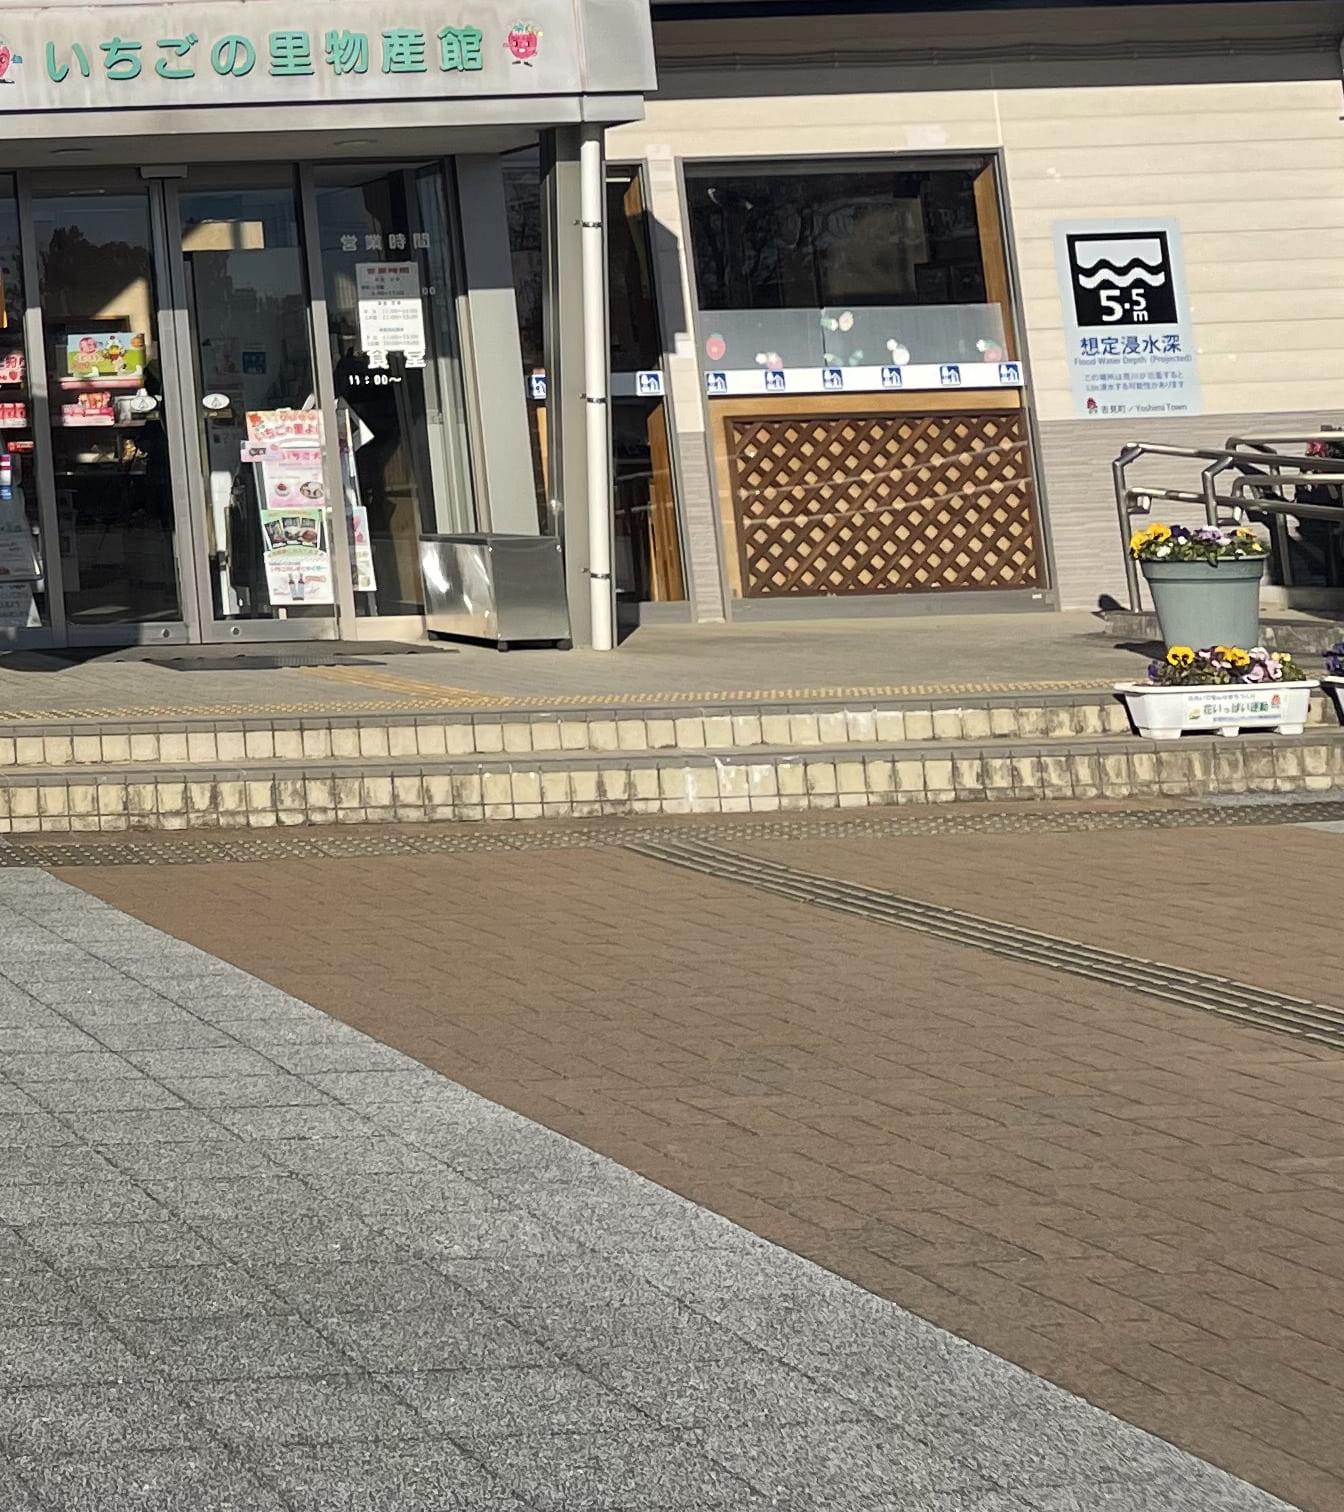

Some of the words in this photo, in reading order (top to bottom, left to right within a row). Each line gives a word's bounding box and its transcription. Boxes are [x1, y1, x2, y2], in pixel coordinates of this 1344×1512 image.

[45, 23, 484, 82] いちごの里物産館
[340, 232, 431, 252] 営業時間
[1080, 334, 1182, 356] 想定浸水深
[1098, 357, 1121, 366] Water
[1122, 355, 1146, 365] Depth
